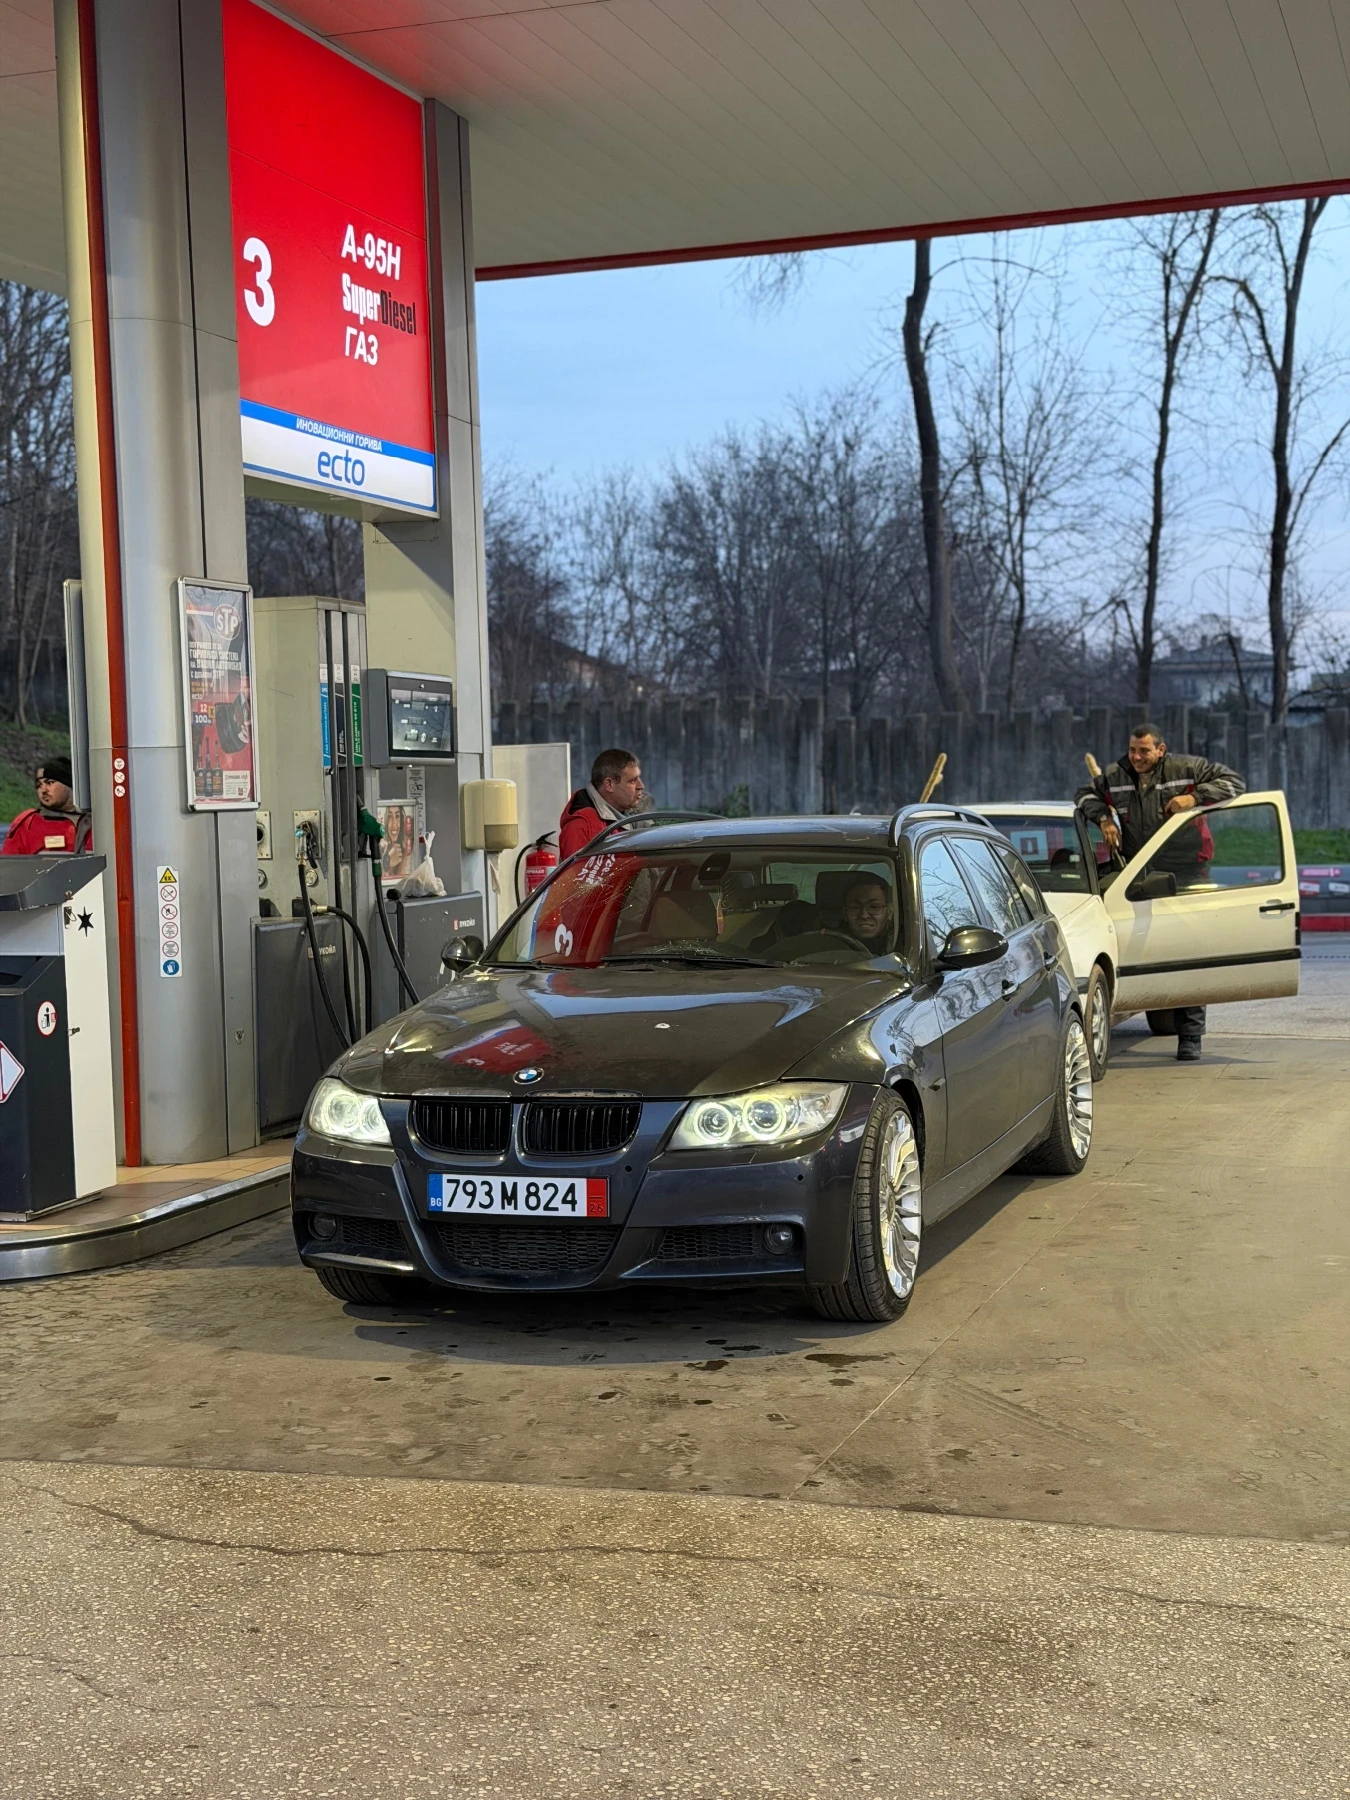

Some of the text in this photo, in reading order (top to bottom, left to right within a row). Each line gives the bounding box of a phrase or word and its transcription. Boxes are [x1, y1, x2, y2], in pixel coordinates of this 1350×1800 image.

[243, 236, 276, 327] 3
[344, 325, 378, 366] ГАЗ
[295, 416, 383, 452] ИНОВАЦИОННИ ГОРИВА
[317, 448, 365, 486] ecto
[194, 714, 208, 724] 100
[318, 944, 336, 956] УКОЙЛ
[430, 1197, 442, 1207] BG
[589, 1202, 604, 1213] 26
